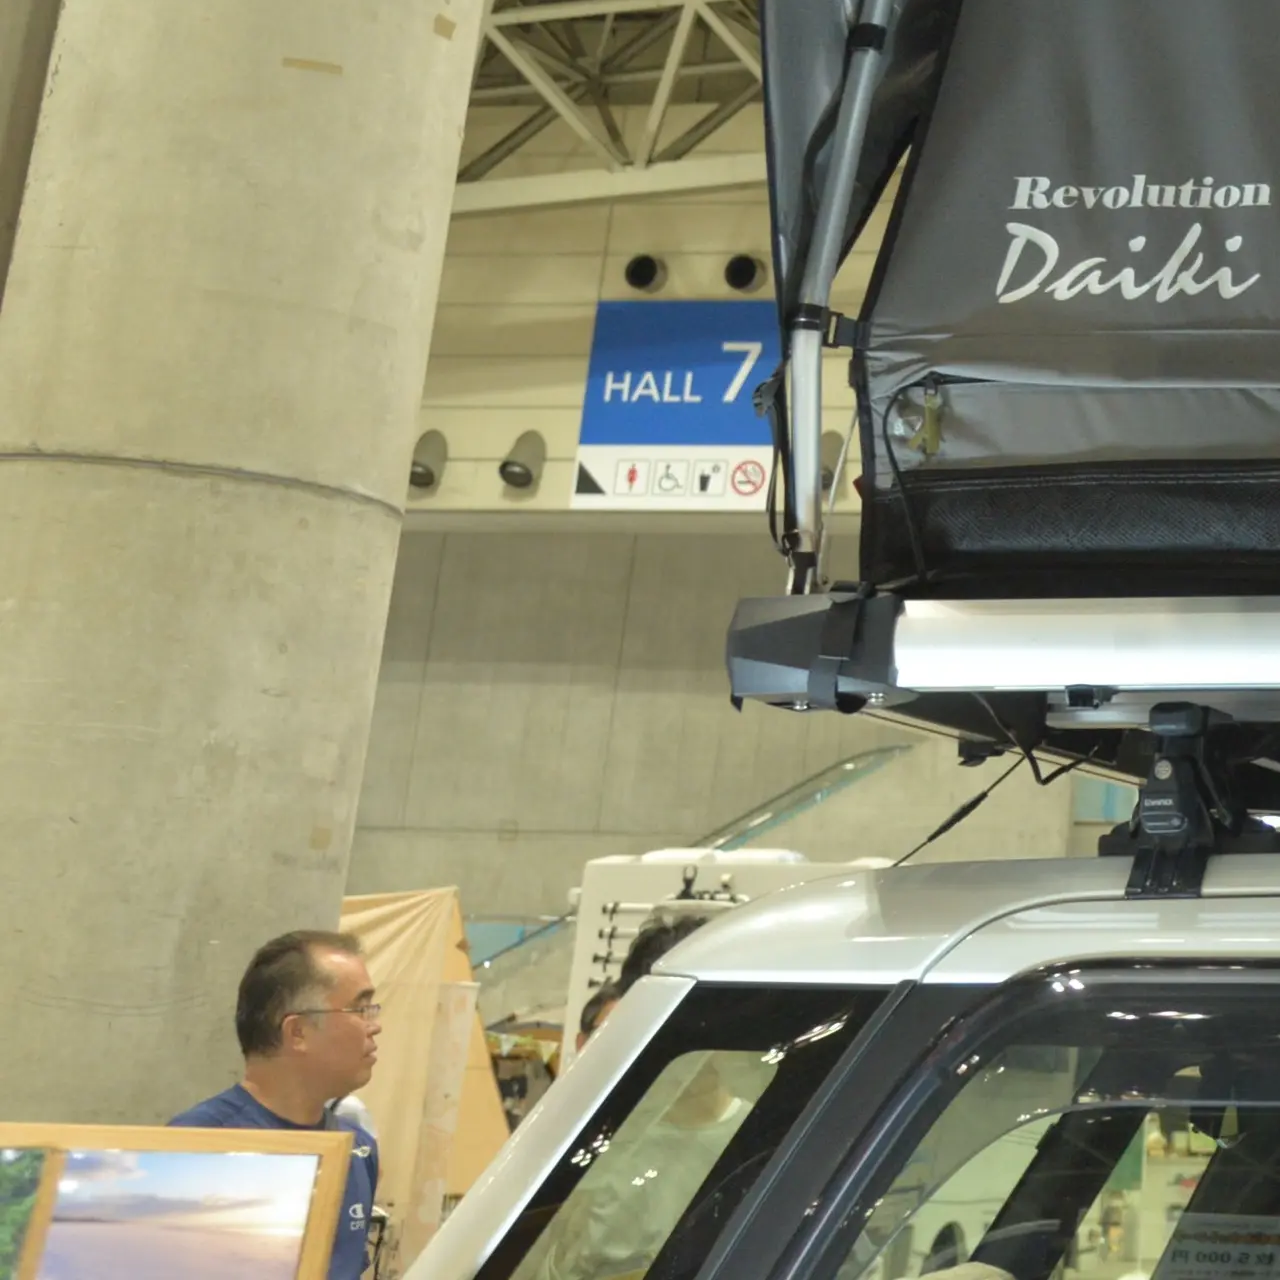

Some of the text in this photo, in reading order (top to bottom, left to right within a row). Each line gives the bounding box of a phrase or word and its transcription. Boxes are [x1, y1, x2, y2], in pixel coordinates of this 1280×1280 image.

[1007, 174, 1271, 209] Revolution
[996, 222, 1261, 303] Daiki
[603, 341, 762, 403] HALL 7
